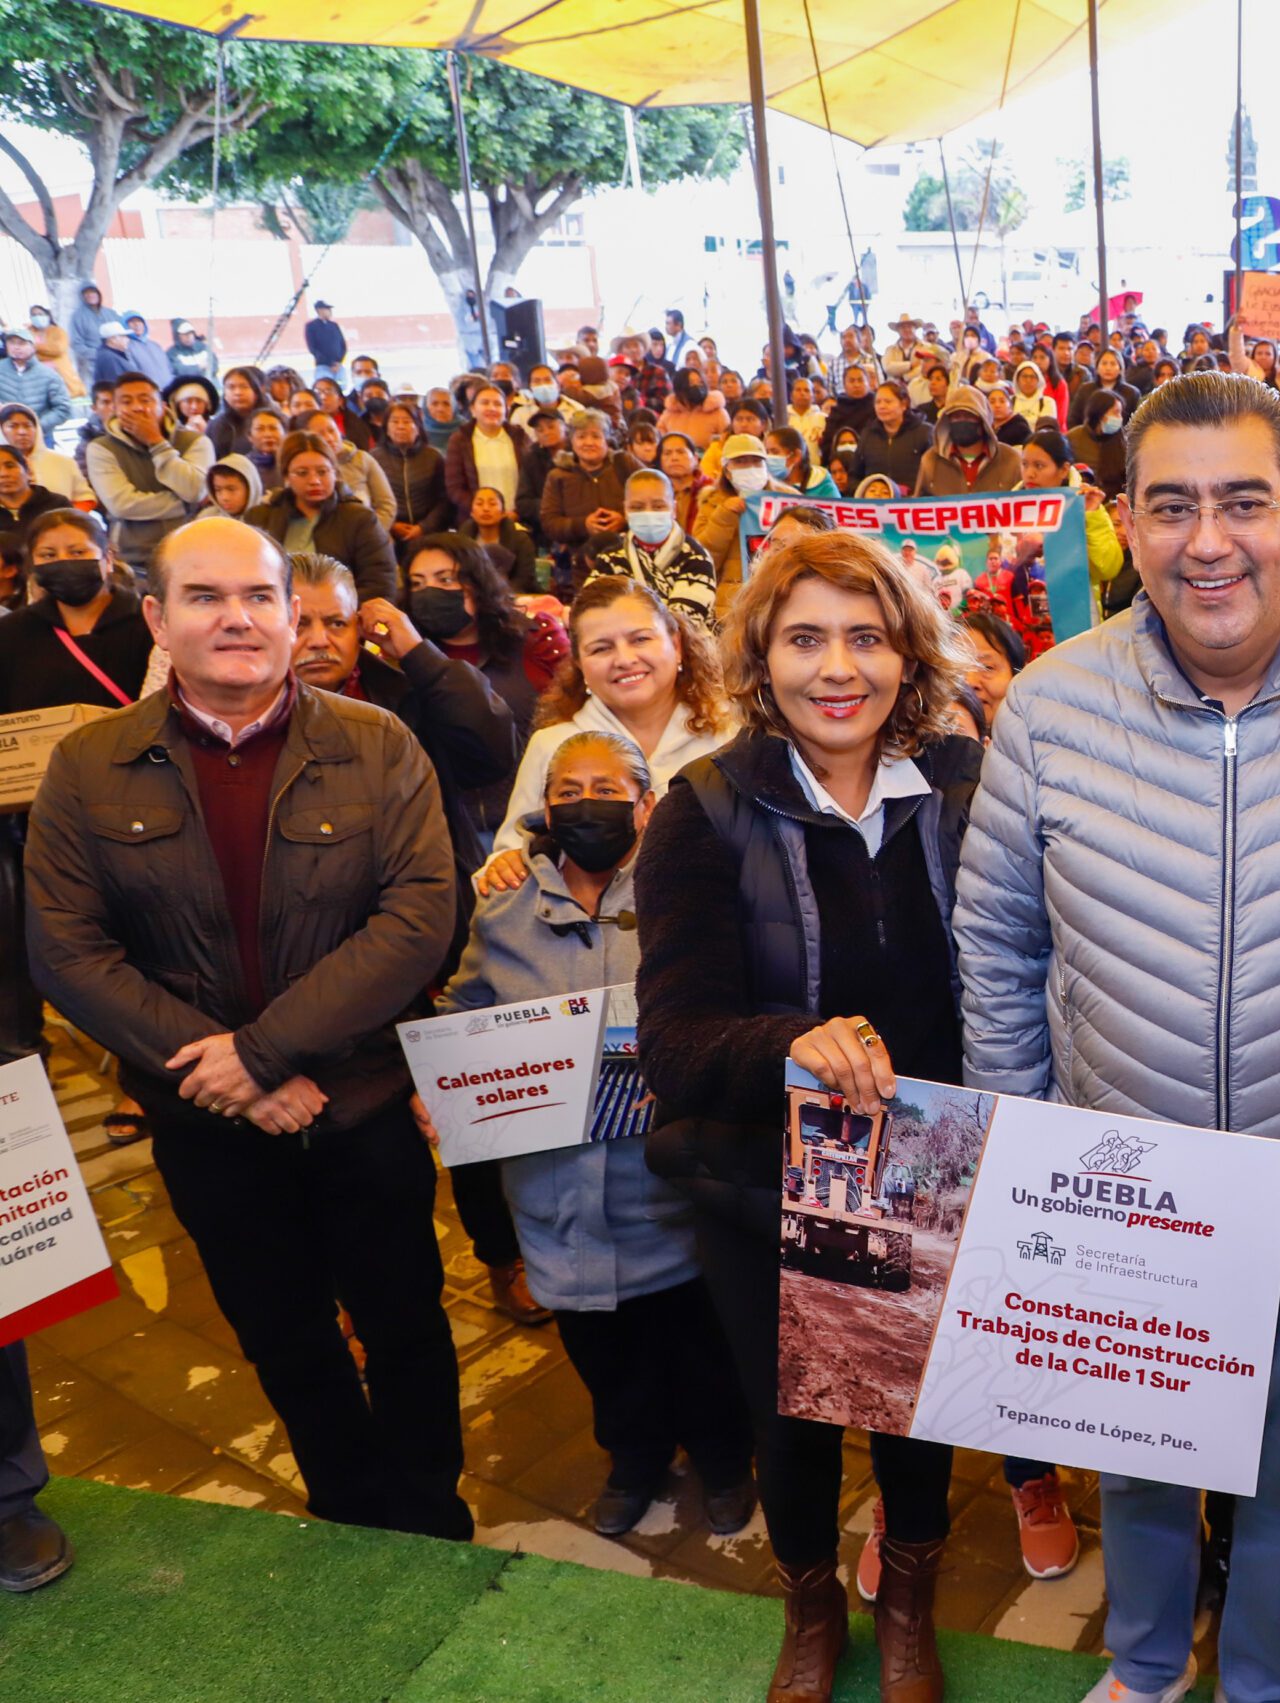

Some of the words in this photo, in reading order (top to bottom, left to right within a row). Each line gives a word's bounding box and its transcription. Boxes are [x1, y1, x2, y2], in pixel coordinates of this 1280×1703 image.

[889, 499, 1062, 531] TEPANCO
[494, 1006, 550, 1023] PUEBLA
[568, 997, 588, 1007] PUE
[570, 1005, 591, 1016] BLA
[436, 1057, 575, 1090] Calentadores
[476, 1082, 549, 1106] solares
[1050, 1172, 1178, 1214] PUEBLA
[0, 1208, 74, 1246] calidad
[1011, 1187, 1038, 1208] Un
[1041, 1196, 1127, 1222] gobierno
[1126, 1212, 1215, 1237] presente
[0, 1235, 57, 1266] uárez
[1076, 1244, 1146, 1267] Secretaría
[1075, 1258, 1092, 1271] de
[1096, 1262, 1198, 1288] Infraestructura
[1004, 1292, 1138, 1332] Constancia
[1142, 1316, 1171, 1337] de
[1175, 1320, 1210, 1343] los
[957, 1310, 1058, 1344] Trabajos
[1062, 1329, 1091, 1349] de
[1095, 1335, 1255, 1377] Construcción
[1015, 1348, 1043, 1367] de
[1048, 1352, 1068, 1372] la
[1072, 1357, 1131, 1383] Calle
[1136, 1368, 1146, 1385] 1
[1149, 1371, 1190, 1392] Sur
[996, 1404, 1071, 1430] Tepanco
[1075, 1419, 1096, 1434] de
[1100, 1422, 1156, 1447] López,
[1161, 1433, 1198, 1452] Pue.
